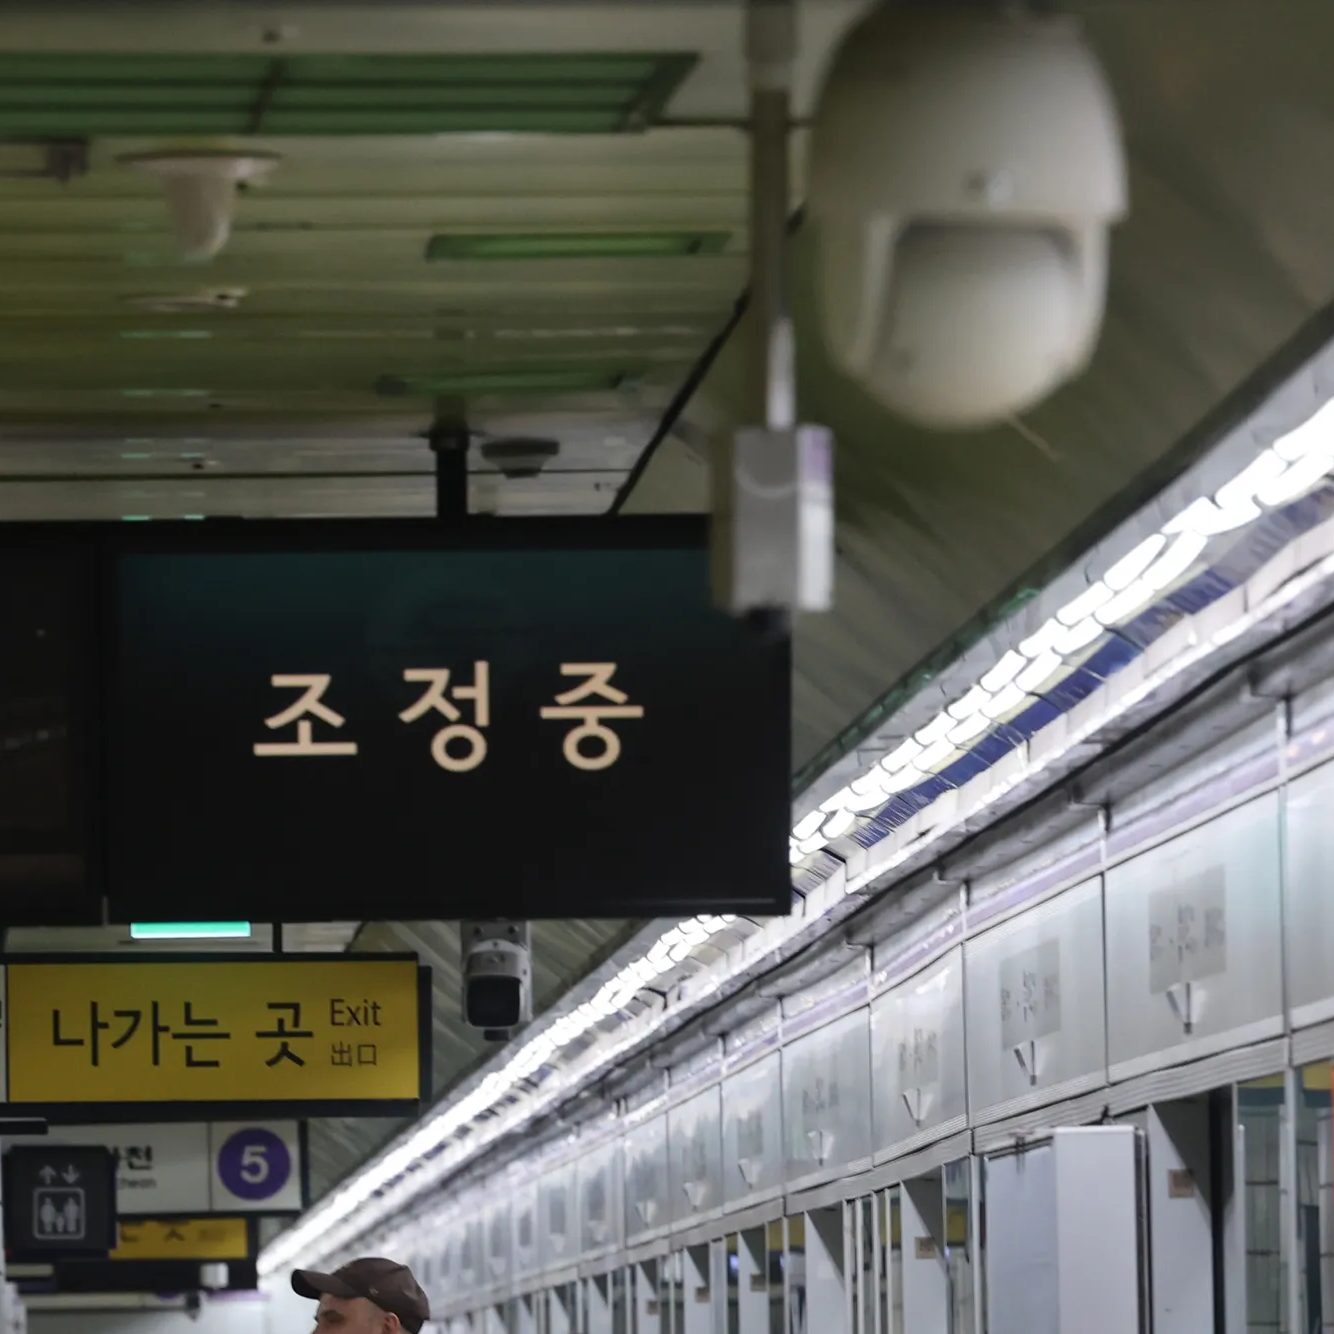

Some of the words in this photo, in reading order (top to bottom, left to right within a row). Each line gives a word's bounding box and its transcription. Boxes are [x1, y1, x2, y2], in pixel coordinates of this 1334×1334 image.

[330, 998, 382, 1027] Exit
[52, 1001, 231, 1068] 나가는
[255, 1002, 314, 1068] 곳
[330, 1042, 377, 1068] 出口
[240, 1145, 269, 1184] 5
